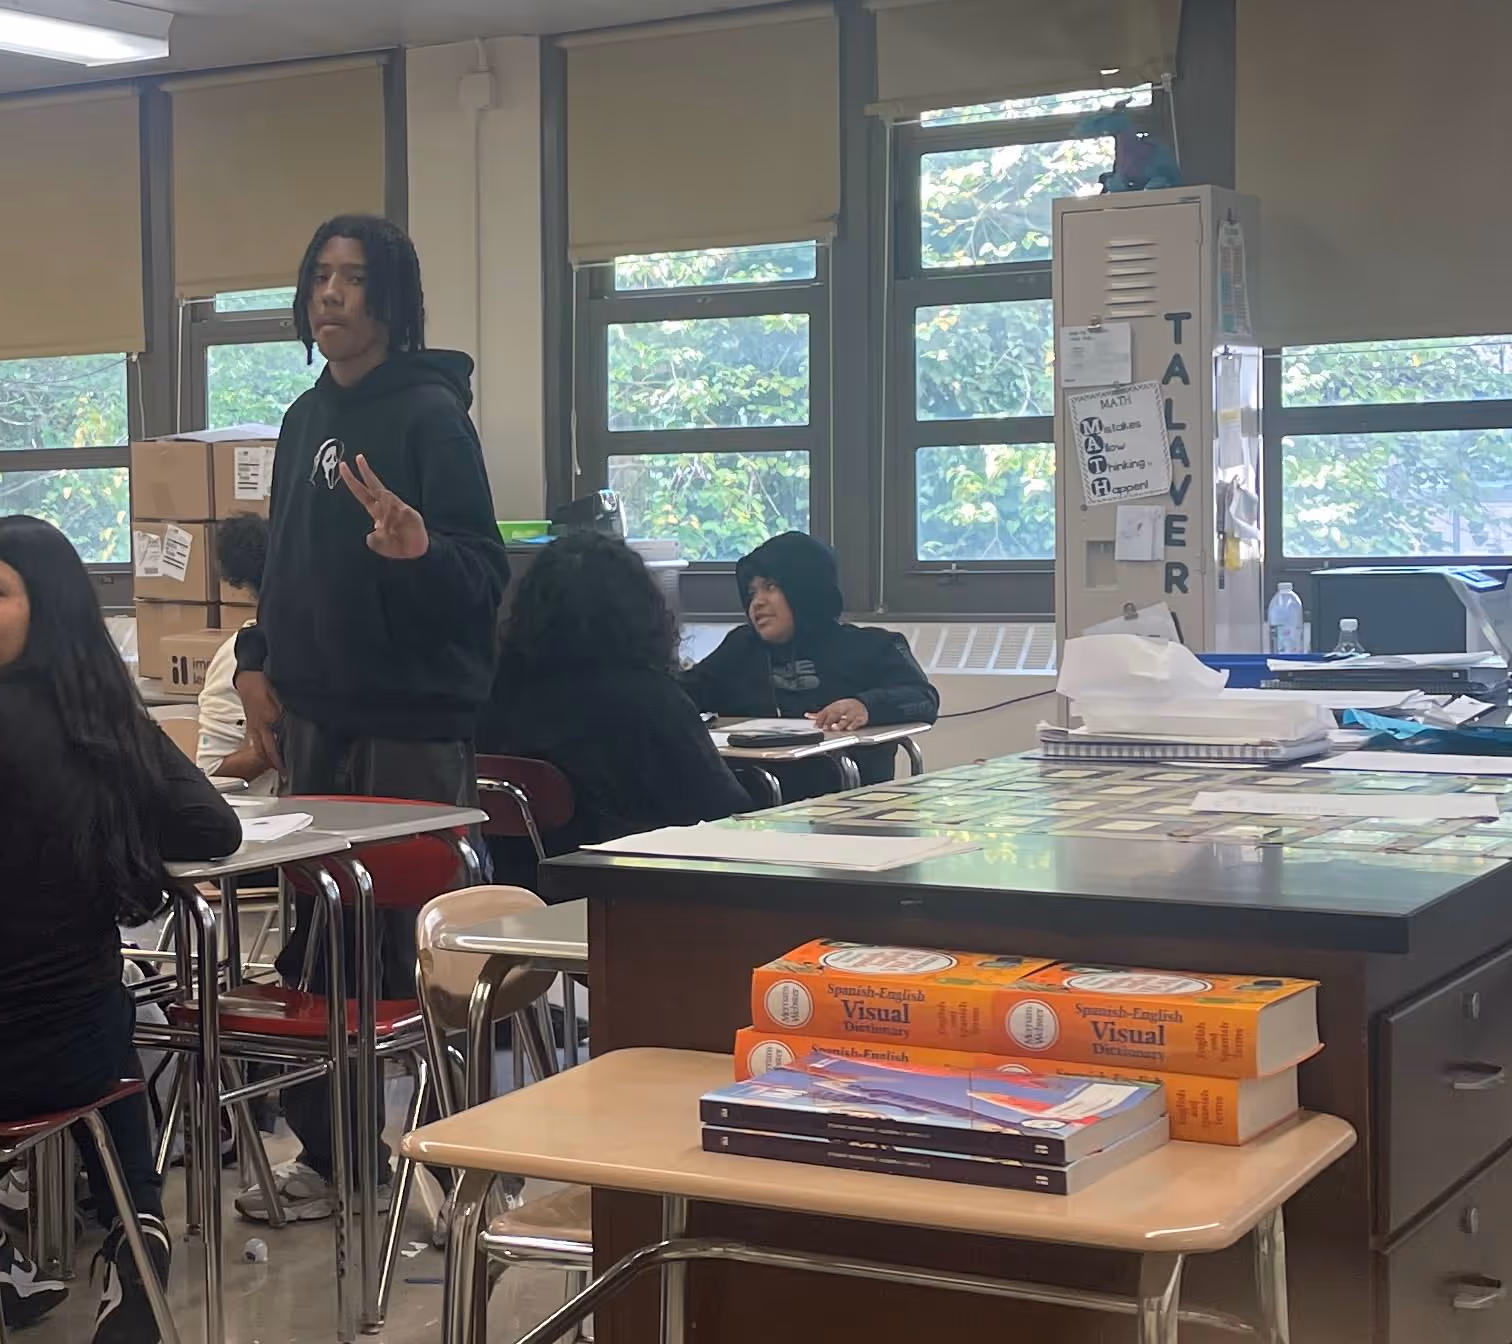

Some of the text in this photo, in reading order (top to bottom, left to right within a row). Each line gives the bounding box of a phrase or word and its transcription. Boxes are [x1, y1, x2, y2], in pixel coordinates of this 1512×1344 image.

[1100, 396, 1132, 409] MATH
[1161, 312, 1192, 644] TALAVER
[827, 983, 925, 1003] Spanish-English
[842, 999, 911, 1024] Visual
[1075, 1002, 1184, 1024] Spanish-English
[843, 1021, 910, 1040] Dictionary
[1091, 1020, 1165, 1046] Visual
[1092, 1043, 1165, 1061] Dictionary
